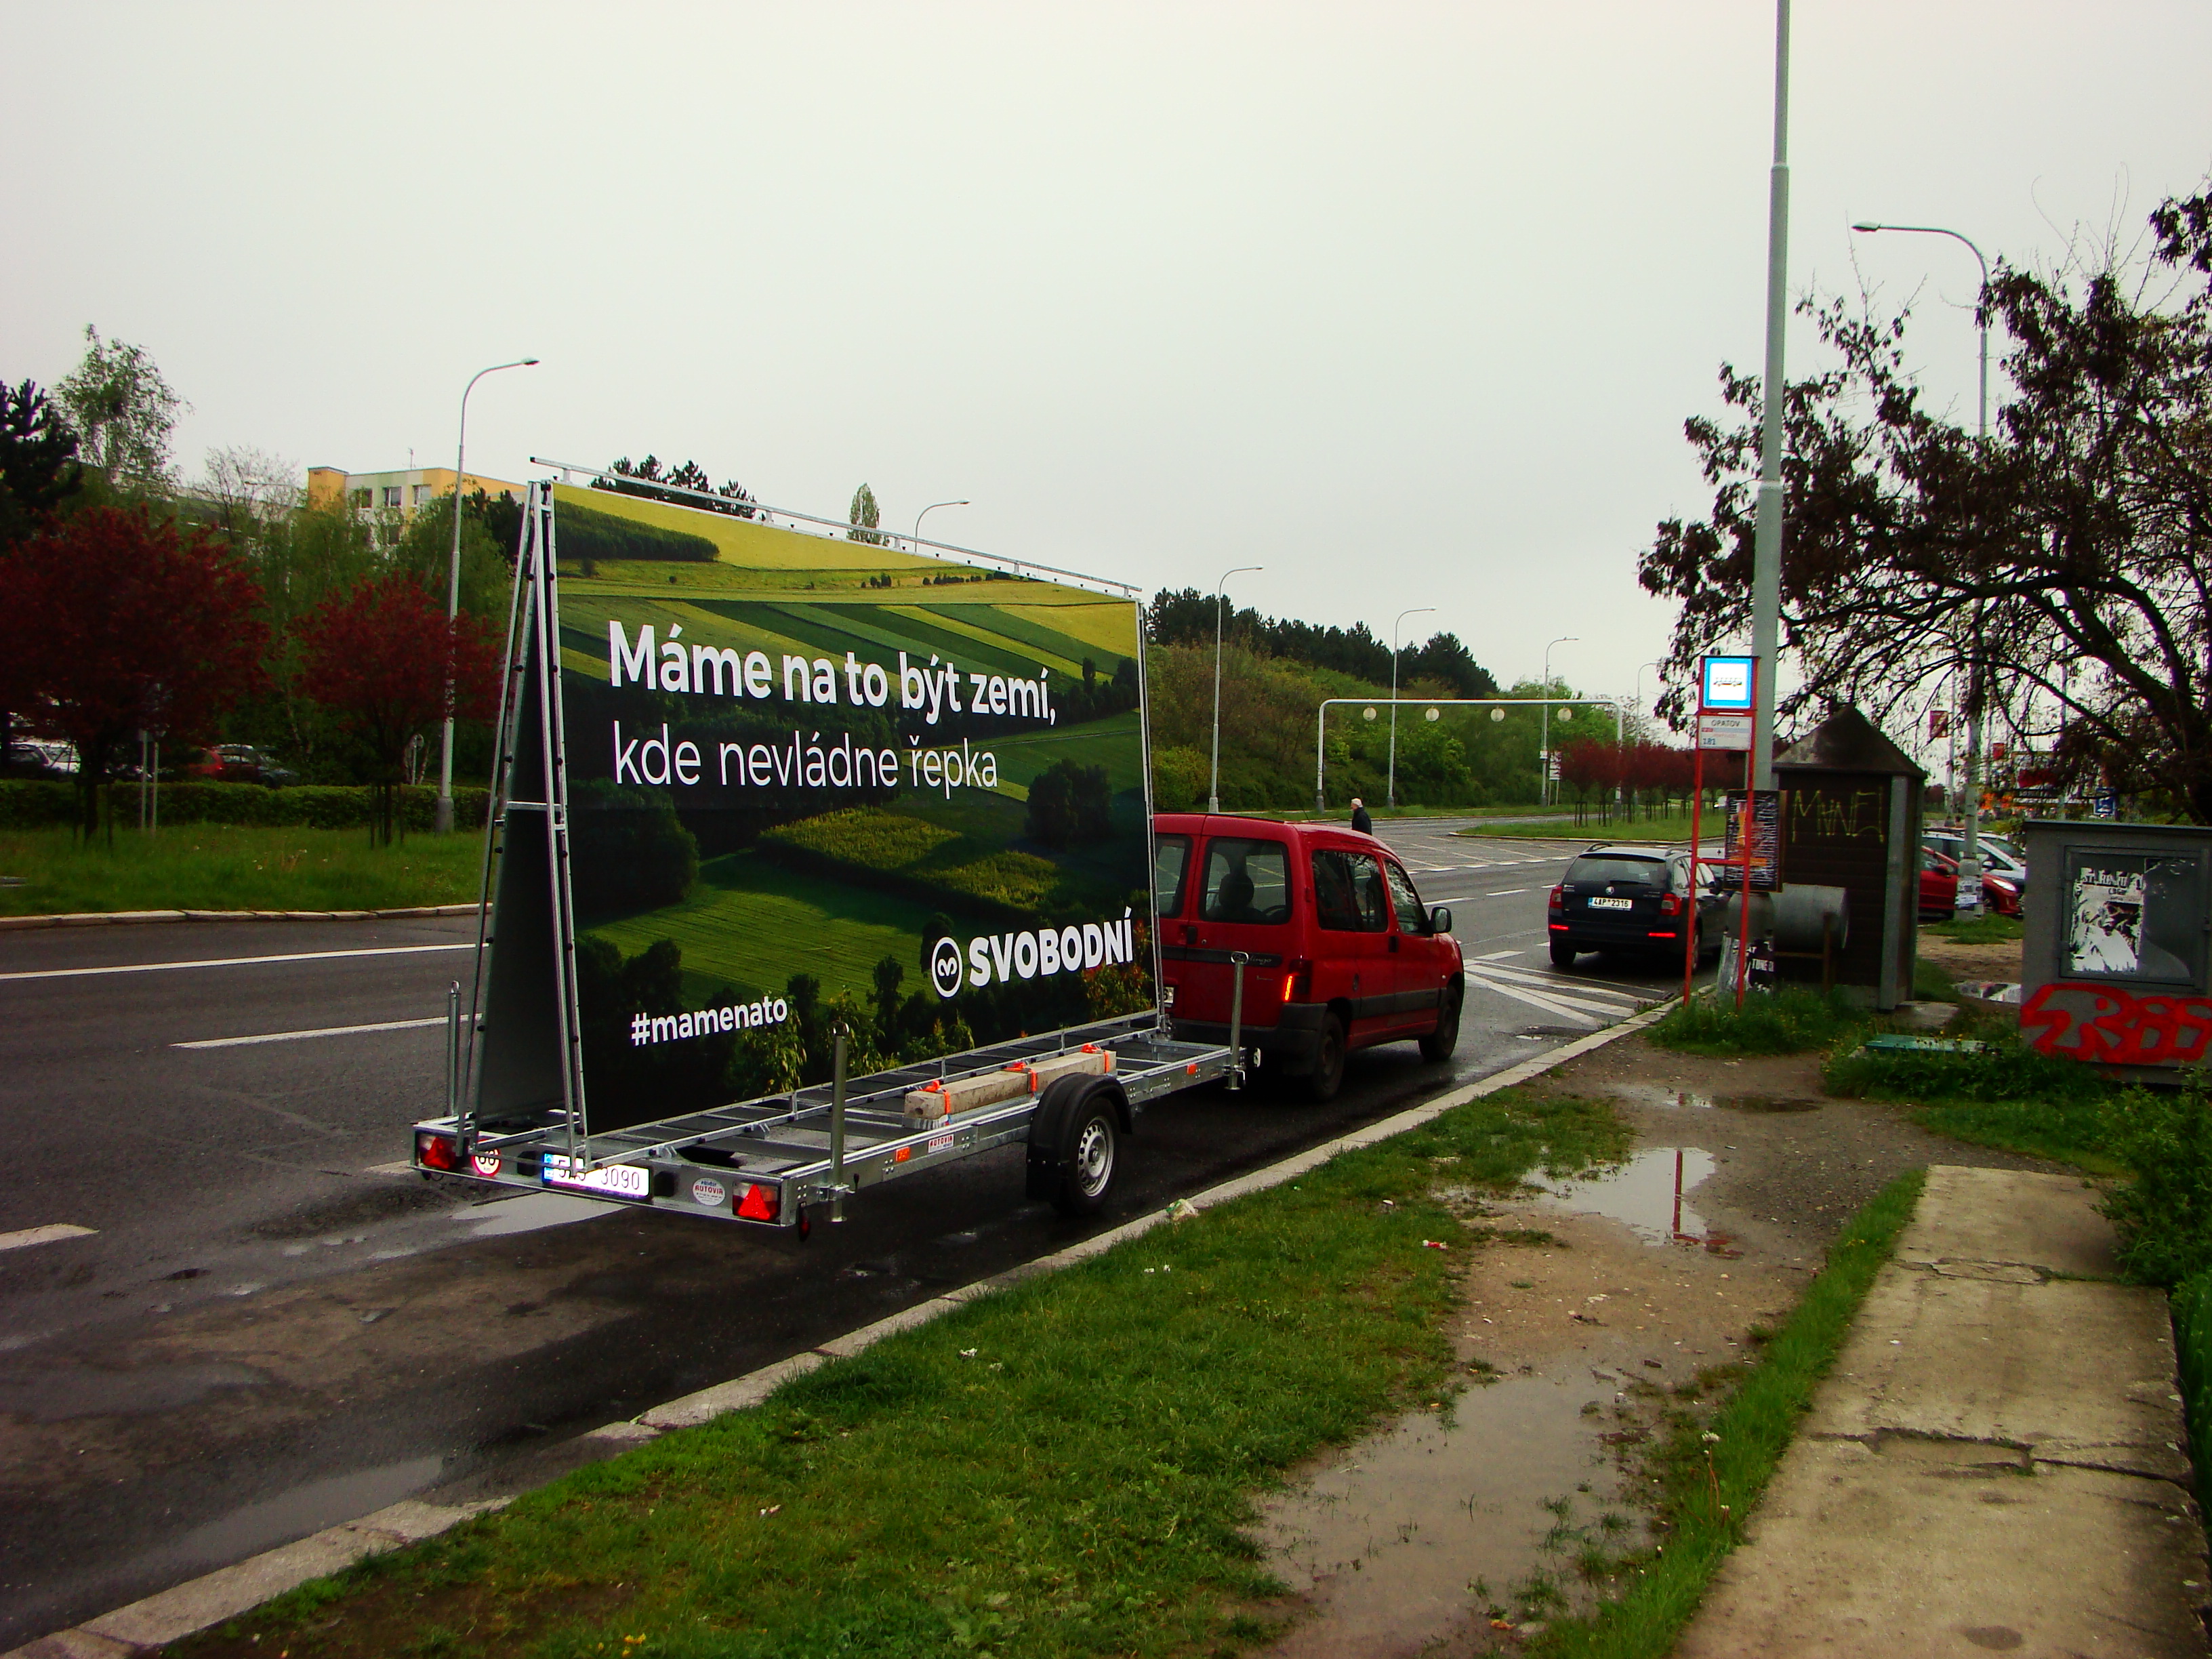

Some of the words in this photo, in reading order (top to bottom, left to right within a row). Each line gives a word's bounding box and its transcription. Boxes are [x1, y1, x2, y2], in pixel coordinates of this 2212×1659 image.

[609, 619, 772, 699] Máme
[783, 655, 837, 703] na
[844, 651, 888, 707] to
[899, 651, 962, 724] být
[970, 667, 1057, 725] zemí,
[614, 720, 701, 785] kde
[720, 730, 899, 787] nevládne
[909, 735, 998, 800] řepka
[968, 906, 1133, 987] SVOBODNÍ
[631, 996, 787, 1046] #mamenato
[930, 1135, 953, 1147] AUTOVIA
[600, 1167, 640, 1190] 3090
[695, 1185, 723, 1195] AUTOVIA
